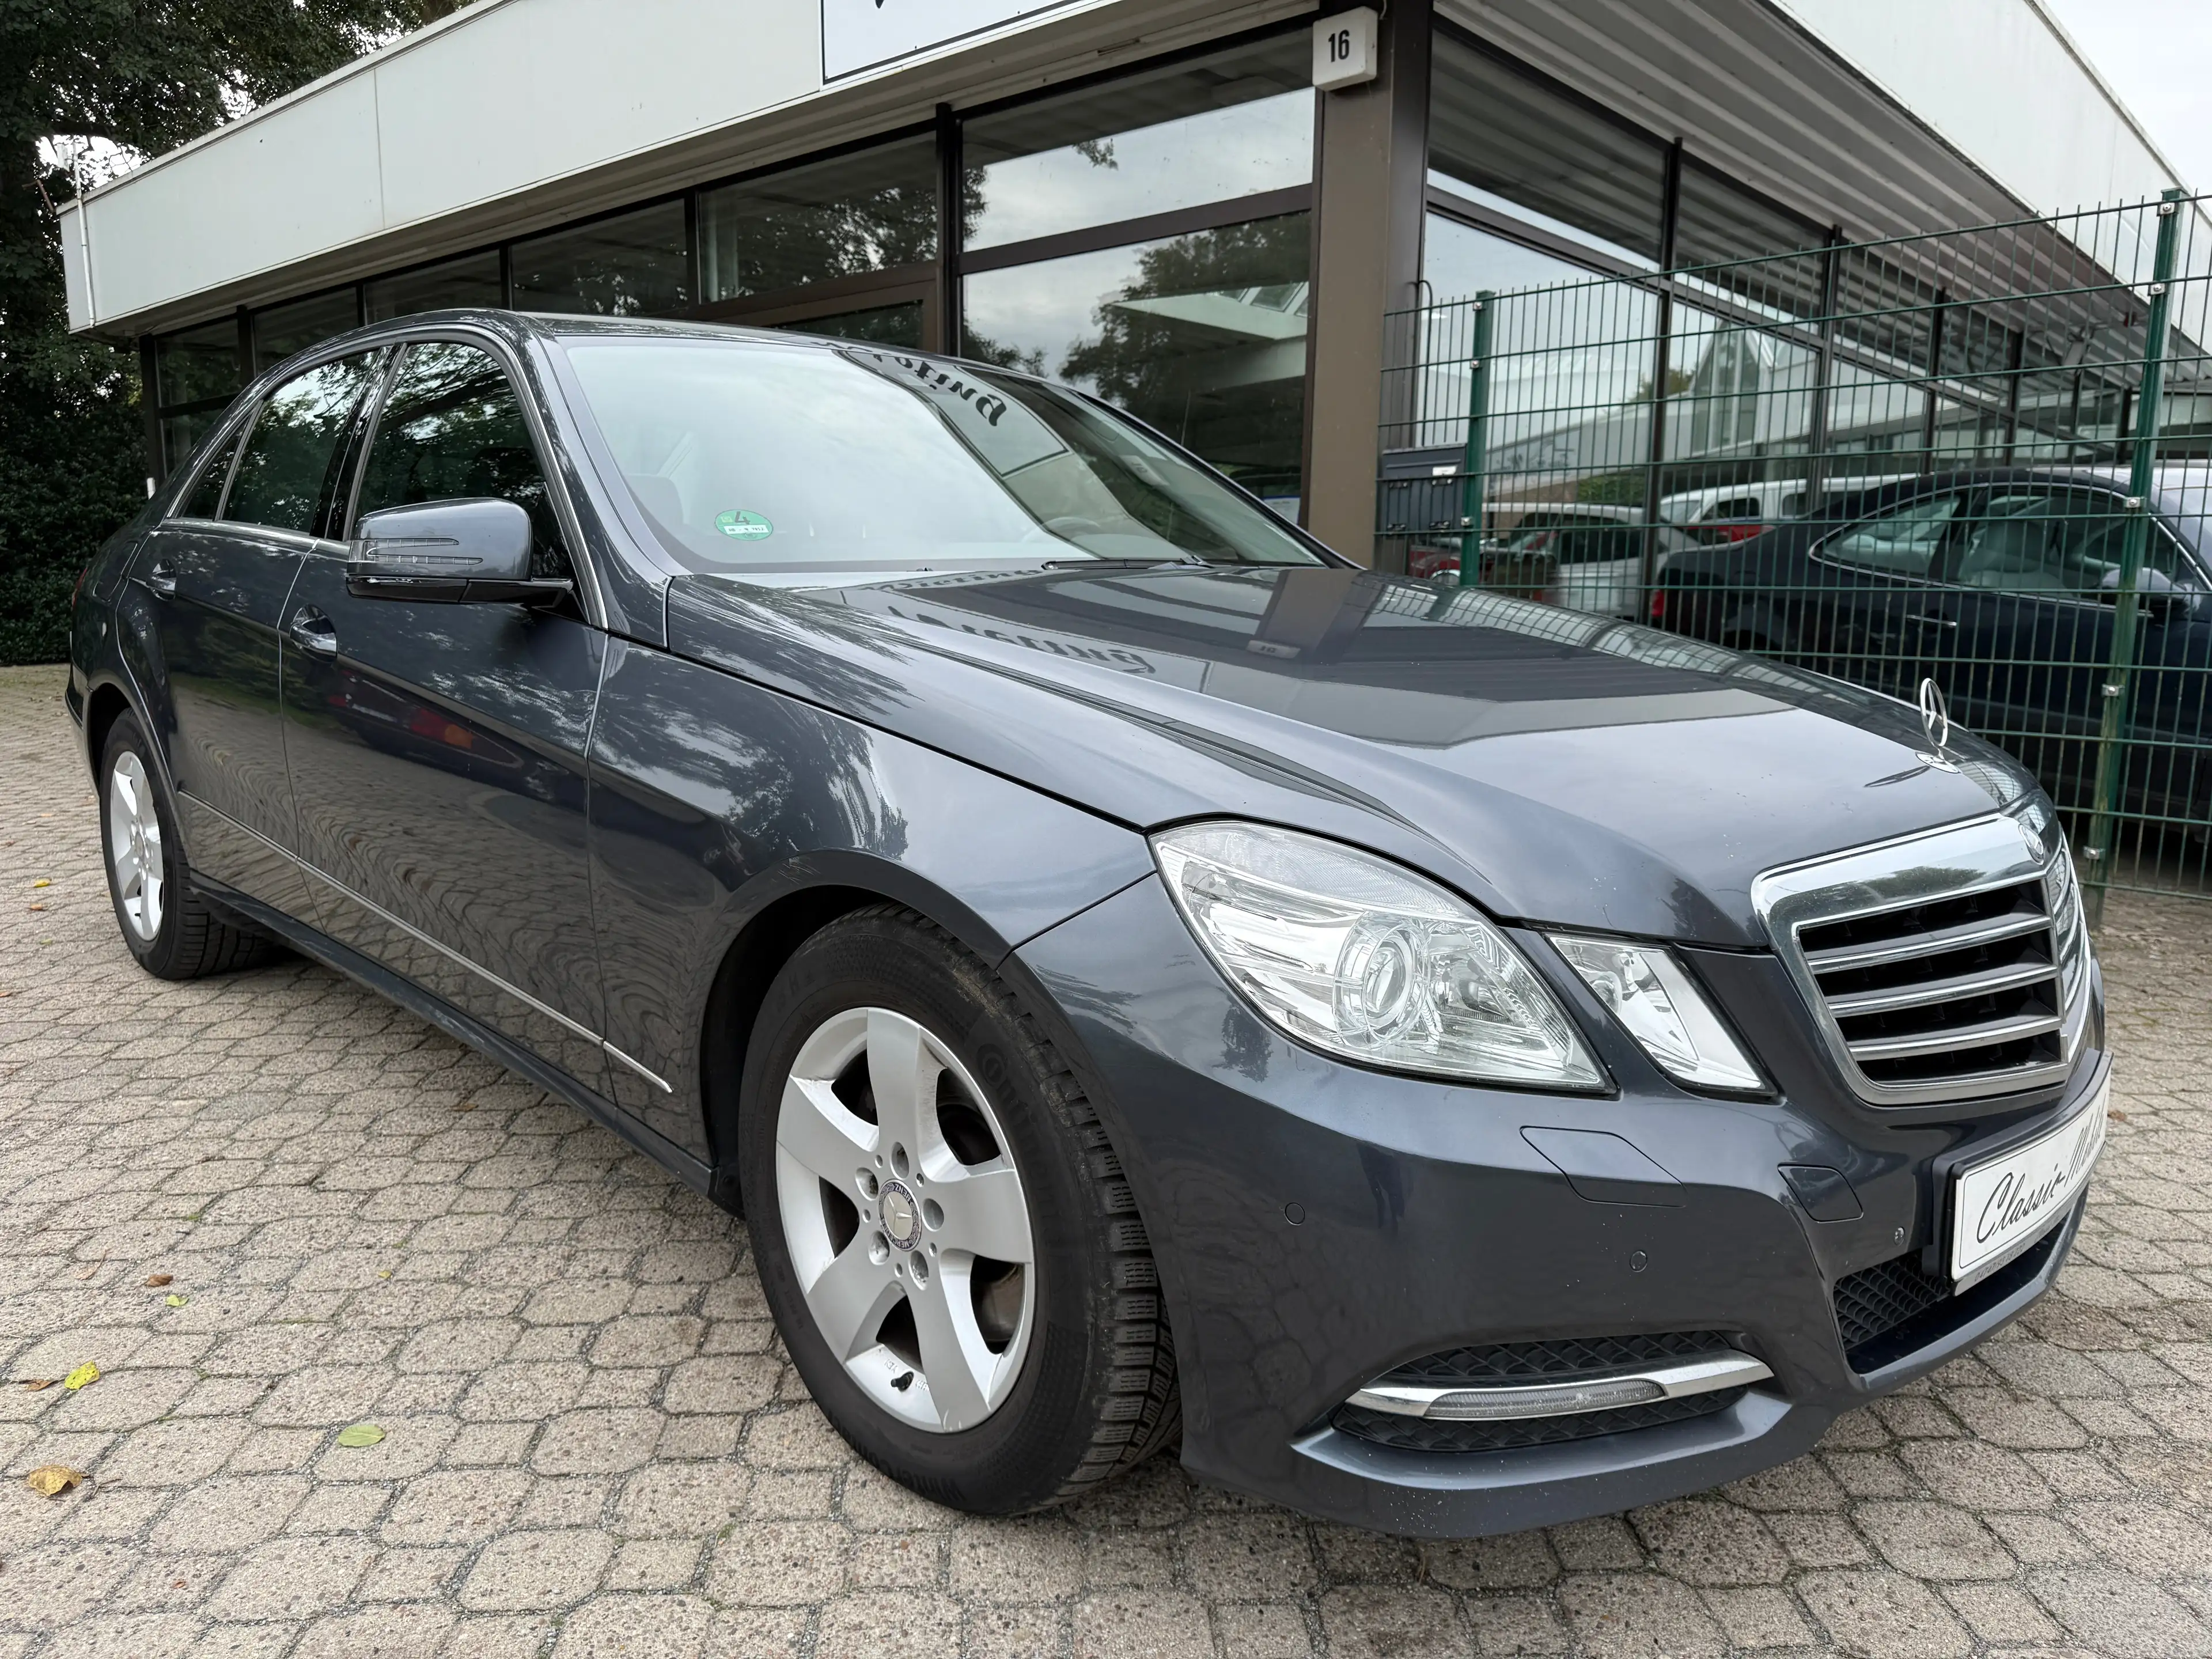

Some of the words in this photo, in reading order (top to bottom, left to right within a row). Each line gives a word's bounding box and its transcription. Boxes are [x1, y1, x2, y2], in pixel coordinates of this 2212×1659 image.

[1328, 28, 1350, 63] 16
[734, 511, 751, 525] 4
[895, 1183, 911, 1202] BENZ
[1976, 1163, 2066, 1244] Classic
[881, 1218, 911, 1249] MERCEDES
